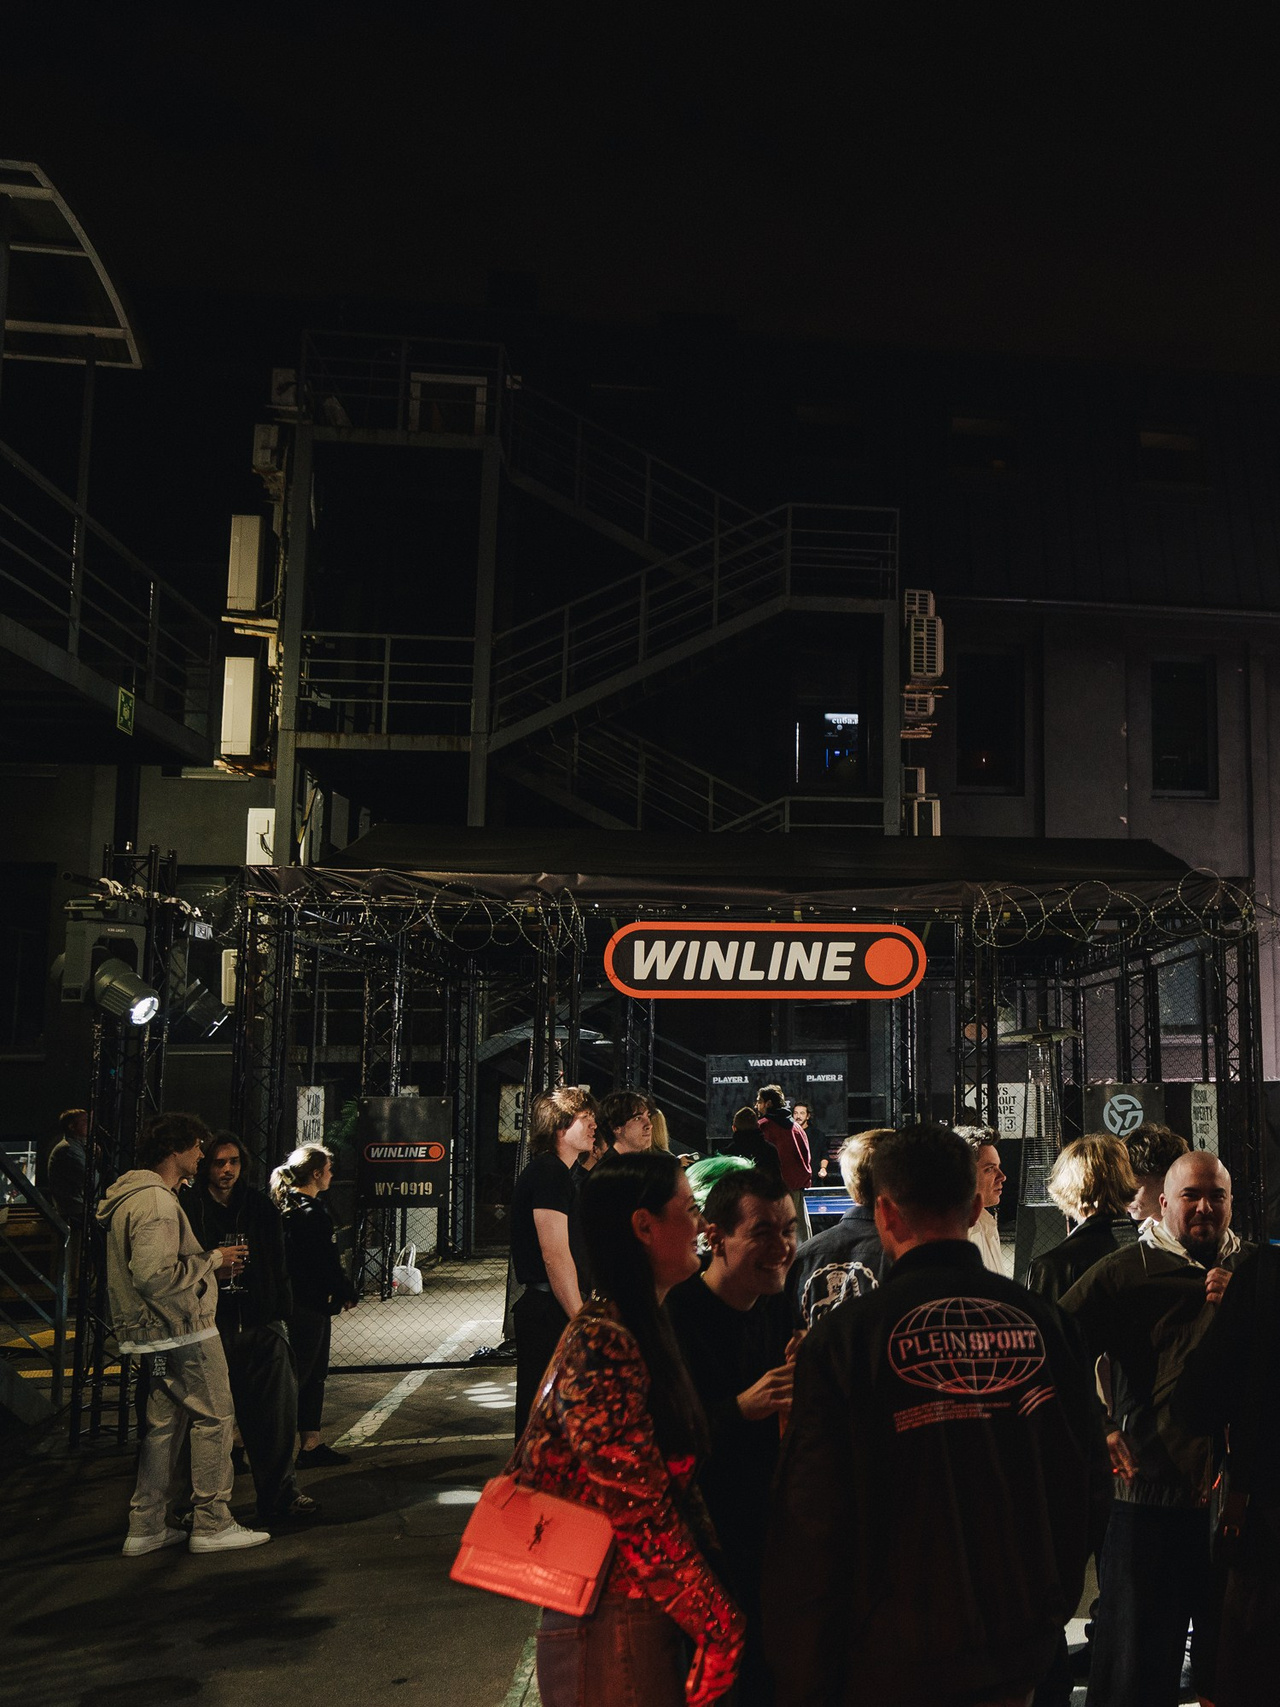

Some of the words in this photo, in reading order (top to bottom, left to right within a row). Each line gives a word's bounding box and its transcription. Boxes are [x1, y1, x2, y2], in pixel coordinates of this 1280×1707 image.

[633, 940, 856, 981] WINLINE
[748, 1059, 773, 1067] YARD
[775, 1058, 807, 1067] MATCH
[712, 1076, 744, 1084] PLAYER
[806, 1074, 836, 1082] PLAYER
[1006, 1119, 1014, 1130] 3
[370, 1146, 428, 1159] WINLINE
[375, 1181, 433, 1196] WY-0919
